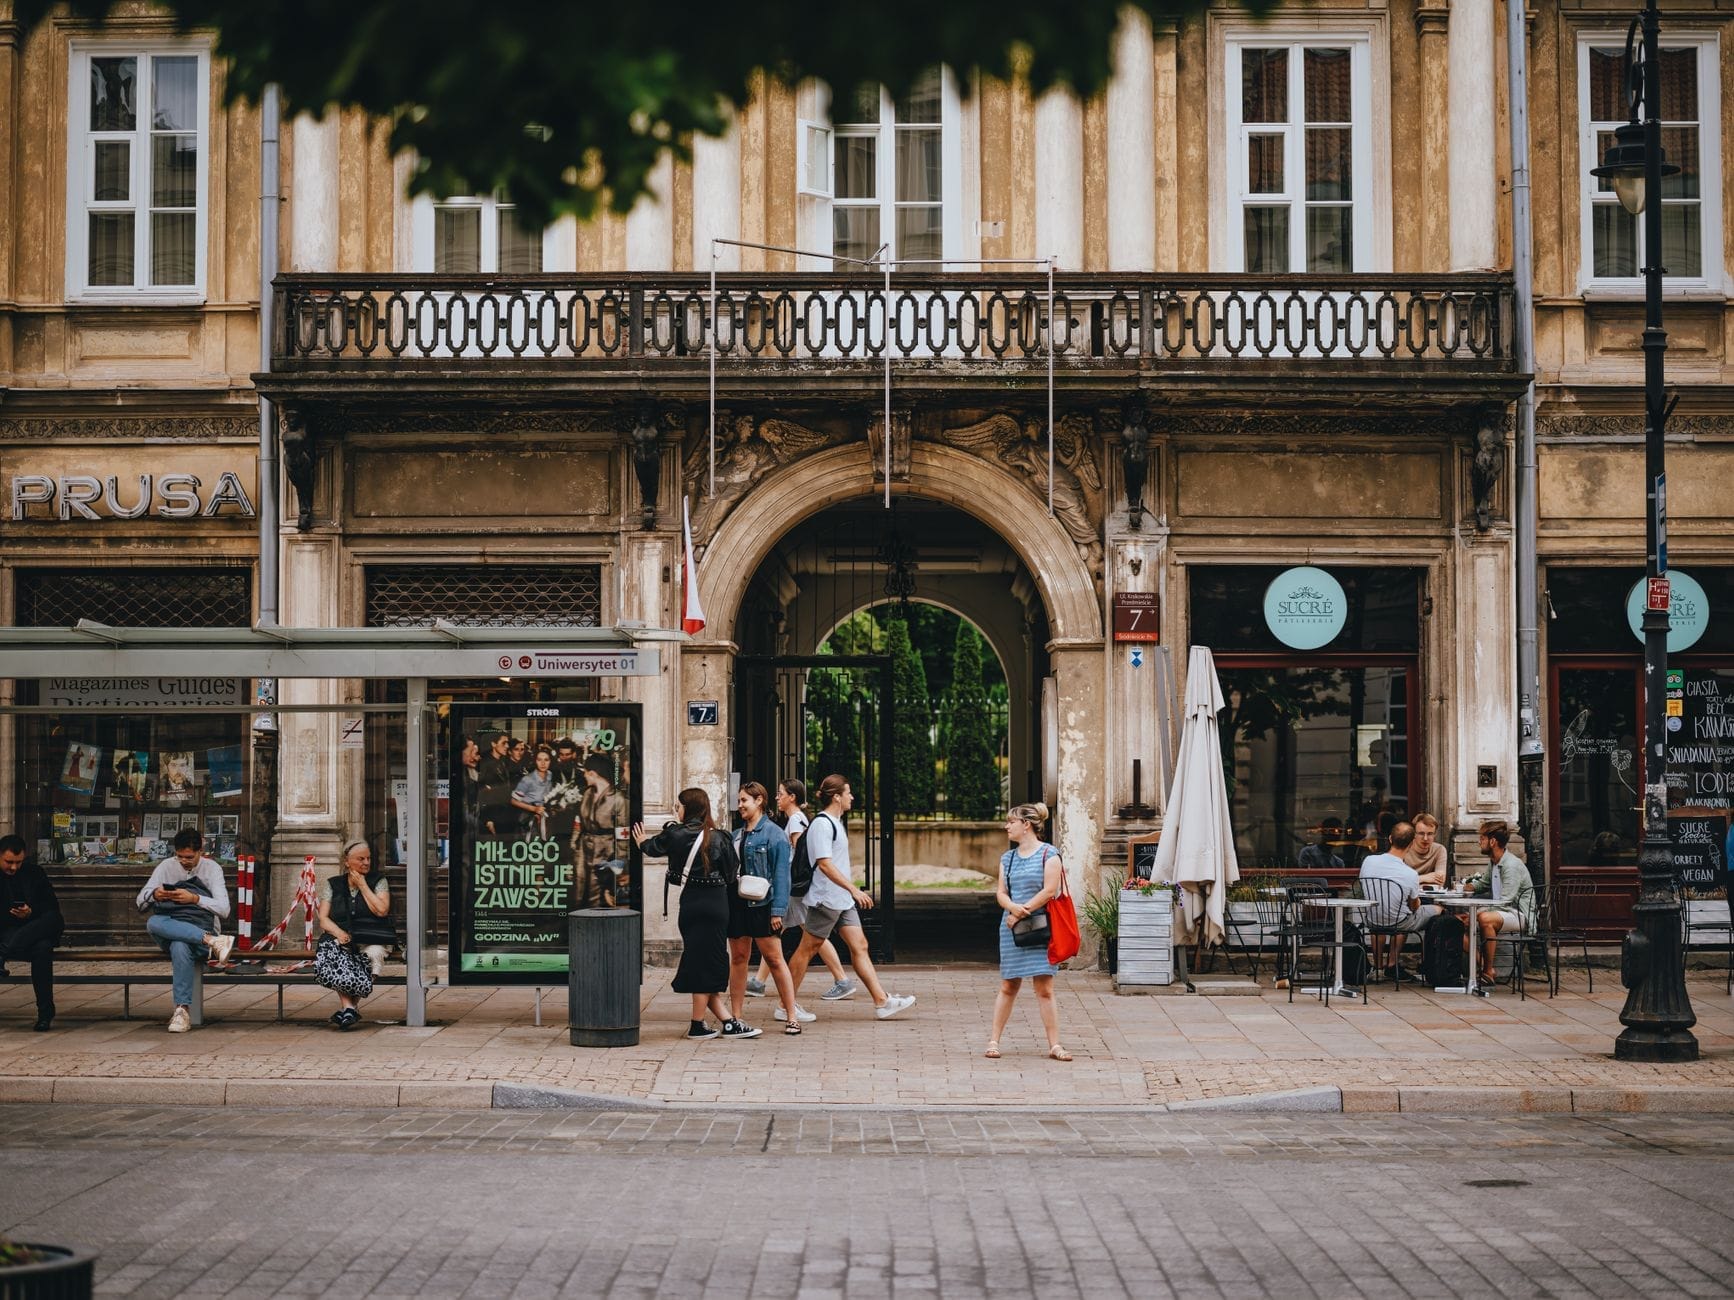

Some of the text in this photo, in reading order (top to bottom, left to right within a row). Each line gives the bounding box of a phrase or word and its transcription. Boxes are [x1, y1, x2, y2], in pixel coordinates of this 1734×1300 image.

[12, 472, 256, 521] PRUSA
[1278, 598, 1333, 614] SUCRÉ
[1130, 609, 1143, 631] 7
[537, 658, 617, 672] Uniwersytet
[620, 658, 635, 670] 01
[49, 678, 150, 694] Magazines
[158, 678, 236, 695] Guides
[1686, 680, 1720, 697] CIASTA
[699, 707, 707, 722] 7
[590, 729, 616, 751] 79
[1695, 772, 1731, 794] LODY
[475, 836, 560, 862] MIŁOŚĆ
[1674, 855, 1703, 865] ORBETY
[474, 864, 574, 886] ISTNIEJE
[1683, 869, 1714, 881] VEGAN
[474, 887, 568, 908] ZAWSZE
[474, 933, 531, 941] GODZINA
